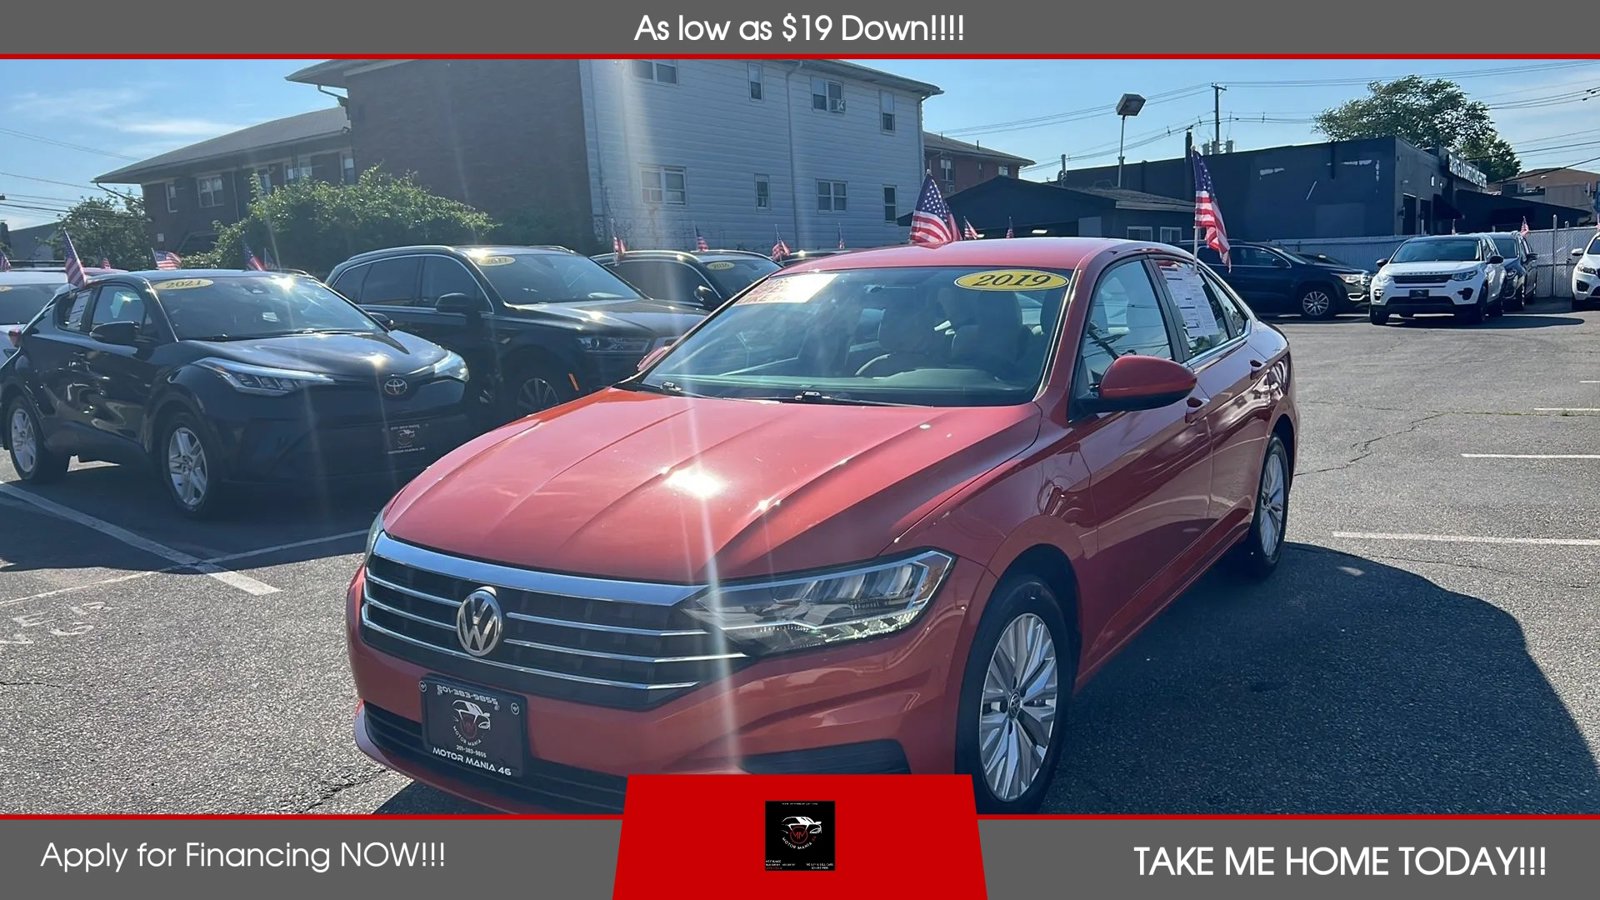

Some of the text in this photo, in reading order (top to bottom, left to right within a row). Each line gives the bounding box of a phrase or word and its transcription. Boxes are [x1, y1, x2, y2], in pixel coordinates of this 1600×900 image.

[166, 280, 202, 289] 2021
[972, 273, 1052, 287] 2019
[432, 746, 464, 763] MOTOR
[465, 756, 497, 773] MANIA
